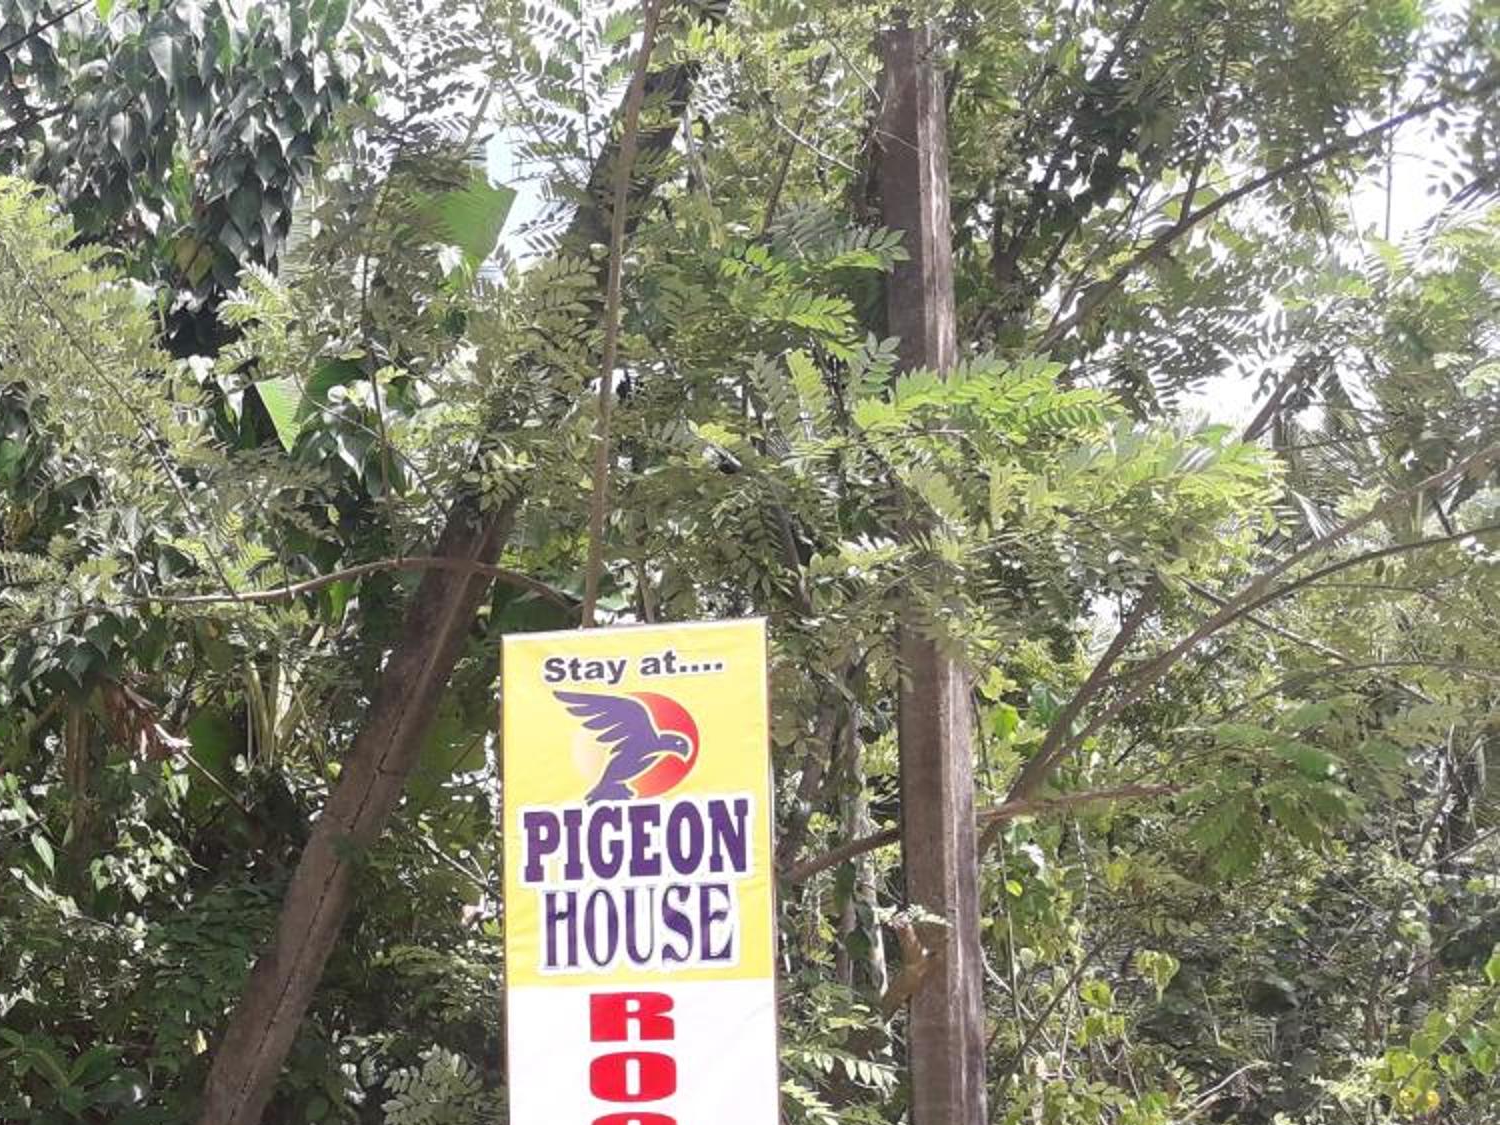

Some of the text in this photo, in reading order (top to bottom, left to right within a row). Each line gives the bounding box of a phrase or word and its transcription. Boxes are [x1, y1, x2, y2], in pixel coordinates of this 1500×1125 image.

[544, 656, 627, 685] Stay
[523, 798, 748, 883] PIGEON
[543, 882, 733, 971] HOUSE
